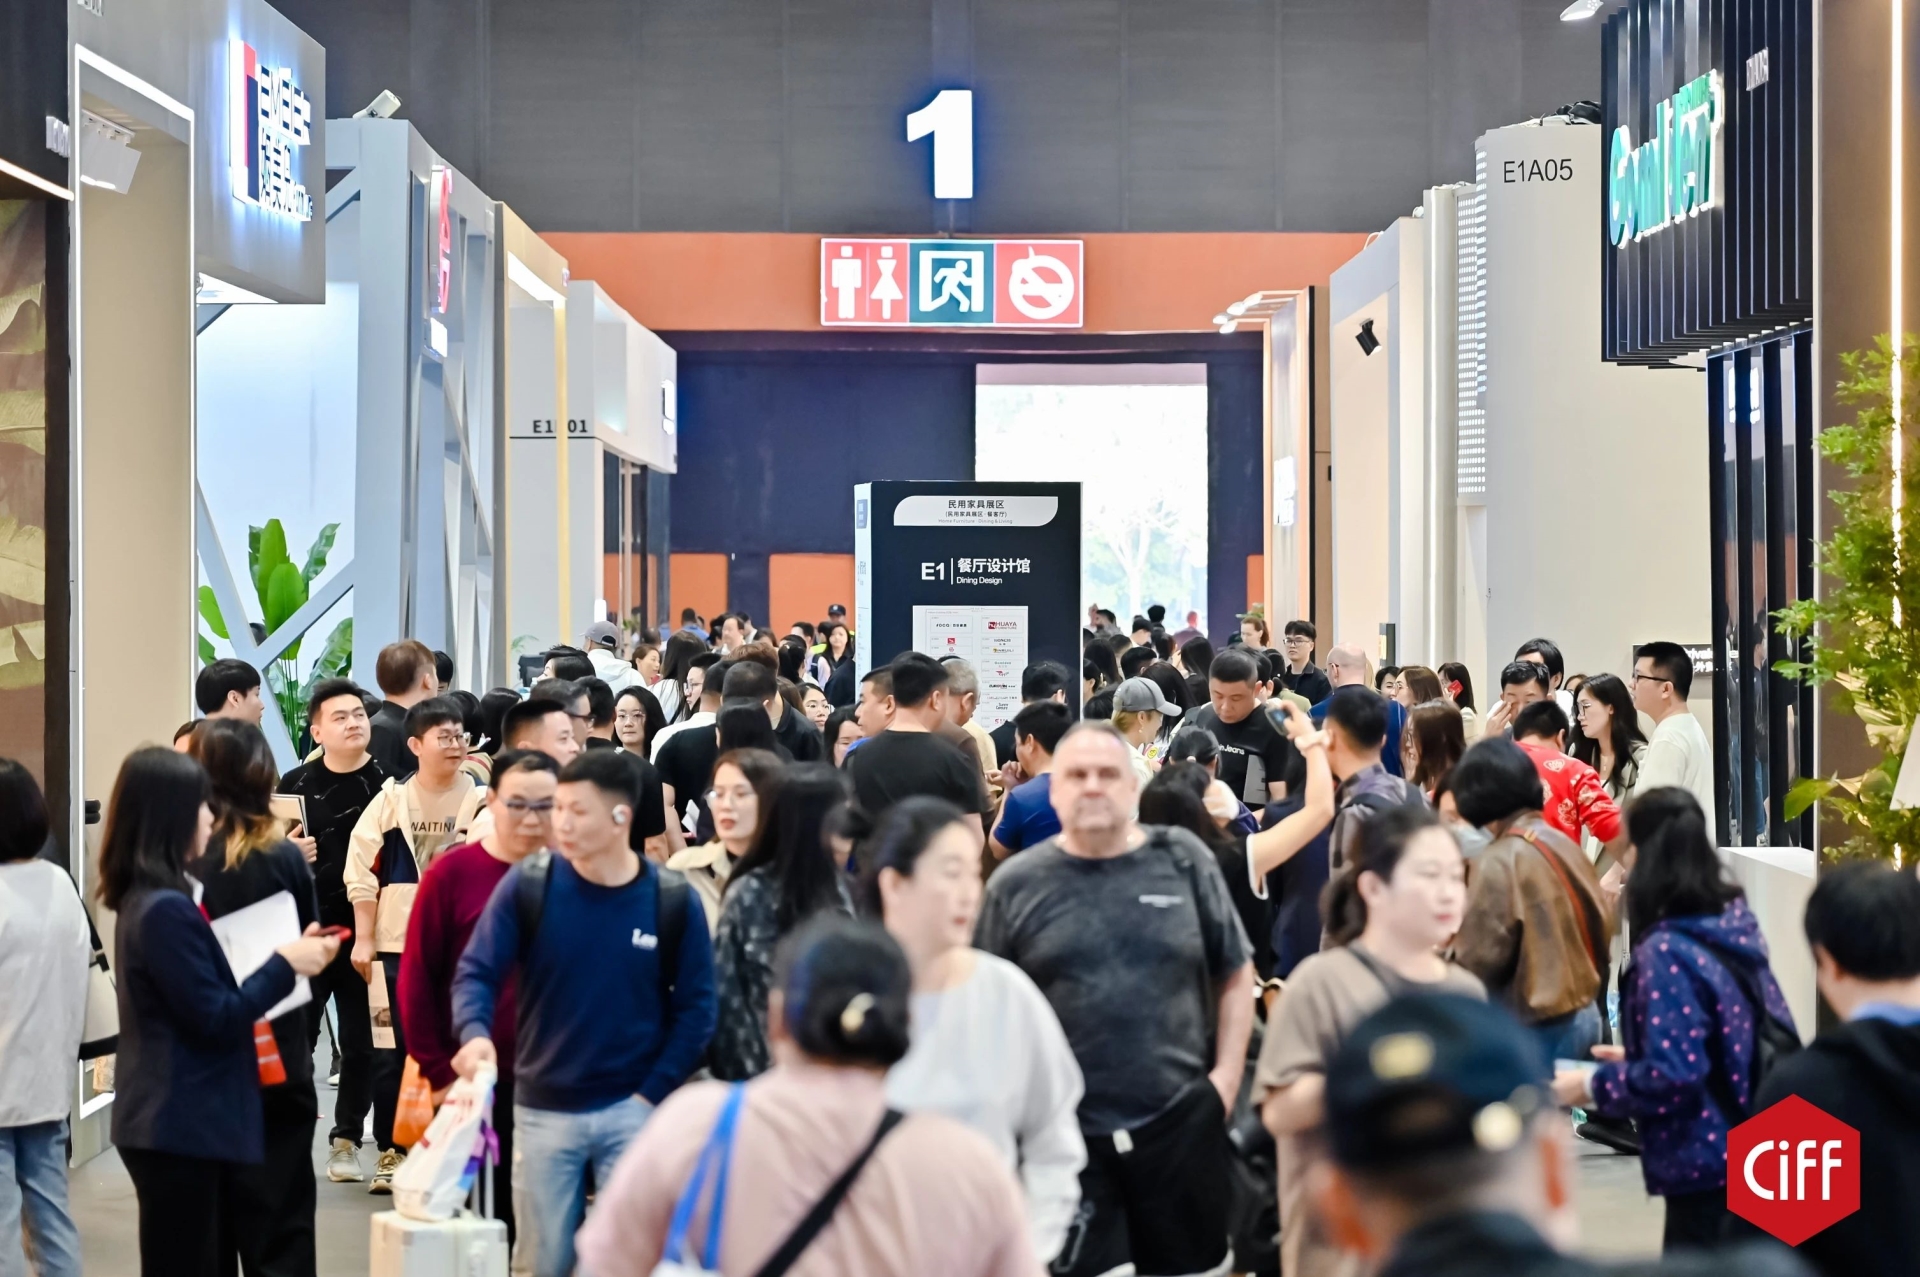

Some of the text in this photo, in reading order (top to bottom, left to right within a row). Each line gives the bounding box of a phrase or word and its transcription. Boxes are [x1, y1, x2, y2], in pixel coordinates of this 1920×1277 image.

[906, 89, 973, 199] 1
[1503, 158, 1573, 183] E1A05
[533, 419, 588, 433] E101
[948, 499, 1005, 509] 民用家具展区
[921, 562, 945, 580] E1
[957, 557, 1031, 574] 餐厅设计馆
[956, 576, 1003, 586] Dining Design
[1224, 744, 1245, 755] Jeans
[410, 821, 456, 833] WAITIN
